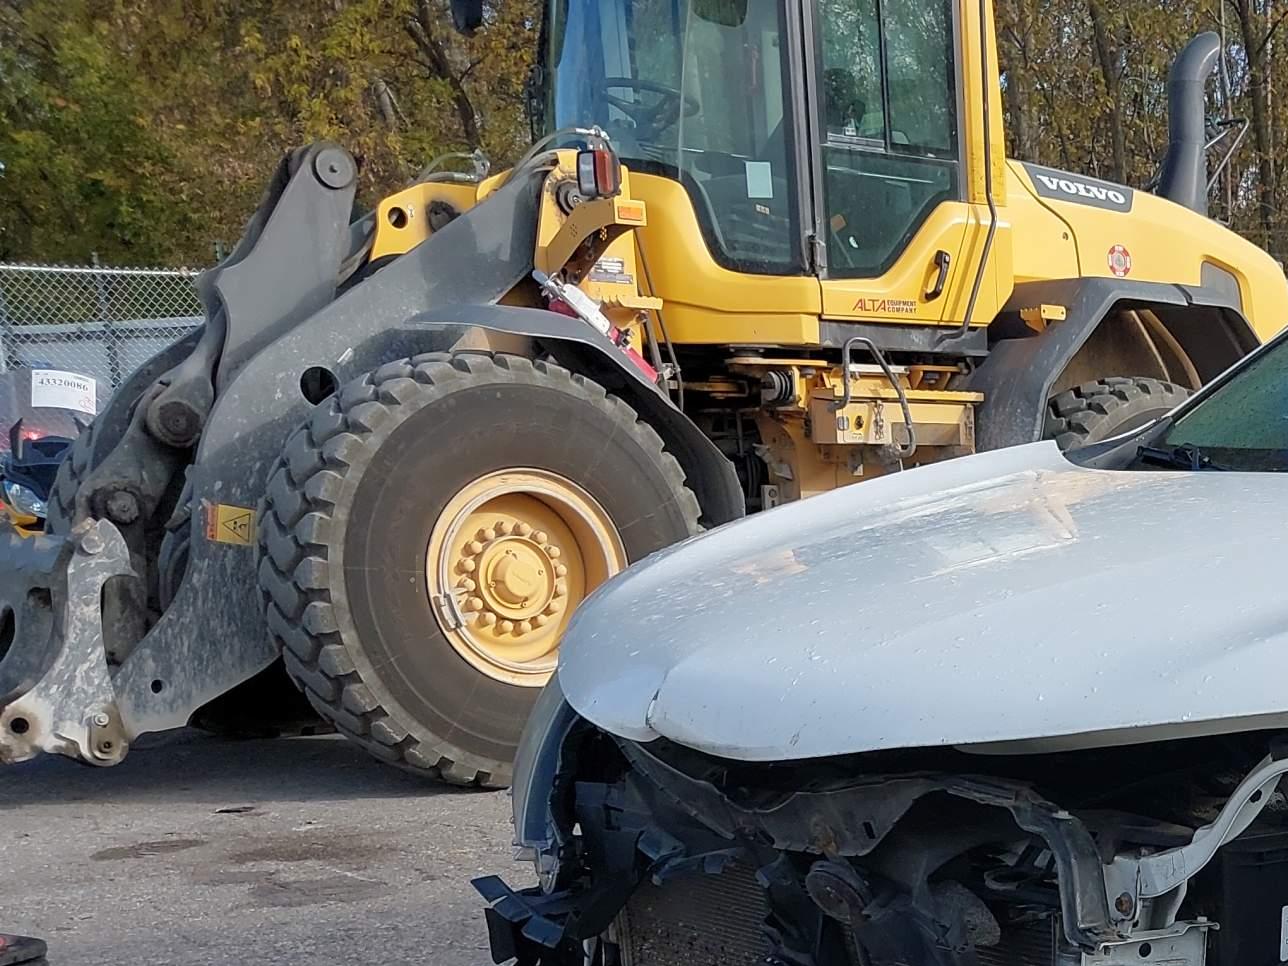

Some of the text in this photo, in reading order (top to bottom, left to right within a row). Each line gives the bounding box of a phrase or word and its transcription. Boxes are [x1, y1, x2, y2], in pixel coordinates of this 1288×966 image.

[1036, 174, 1126, 204] VOLVO
[852, 298, 887, 312] ALTA
[887, 299, 917, 307] EQUIPMENT
[887, 306, 917, 314] COMPANY
